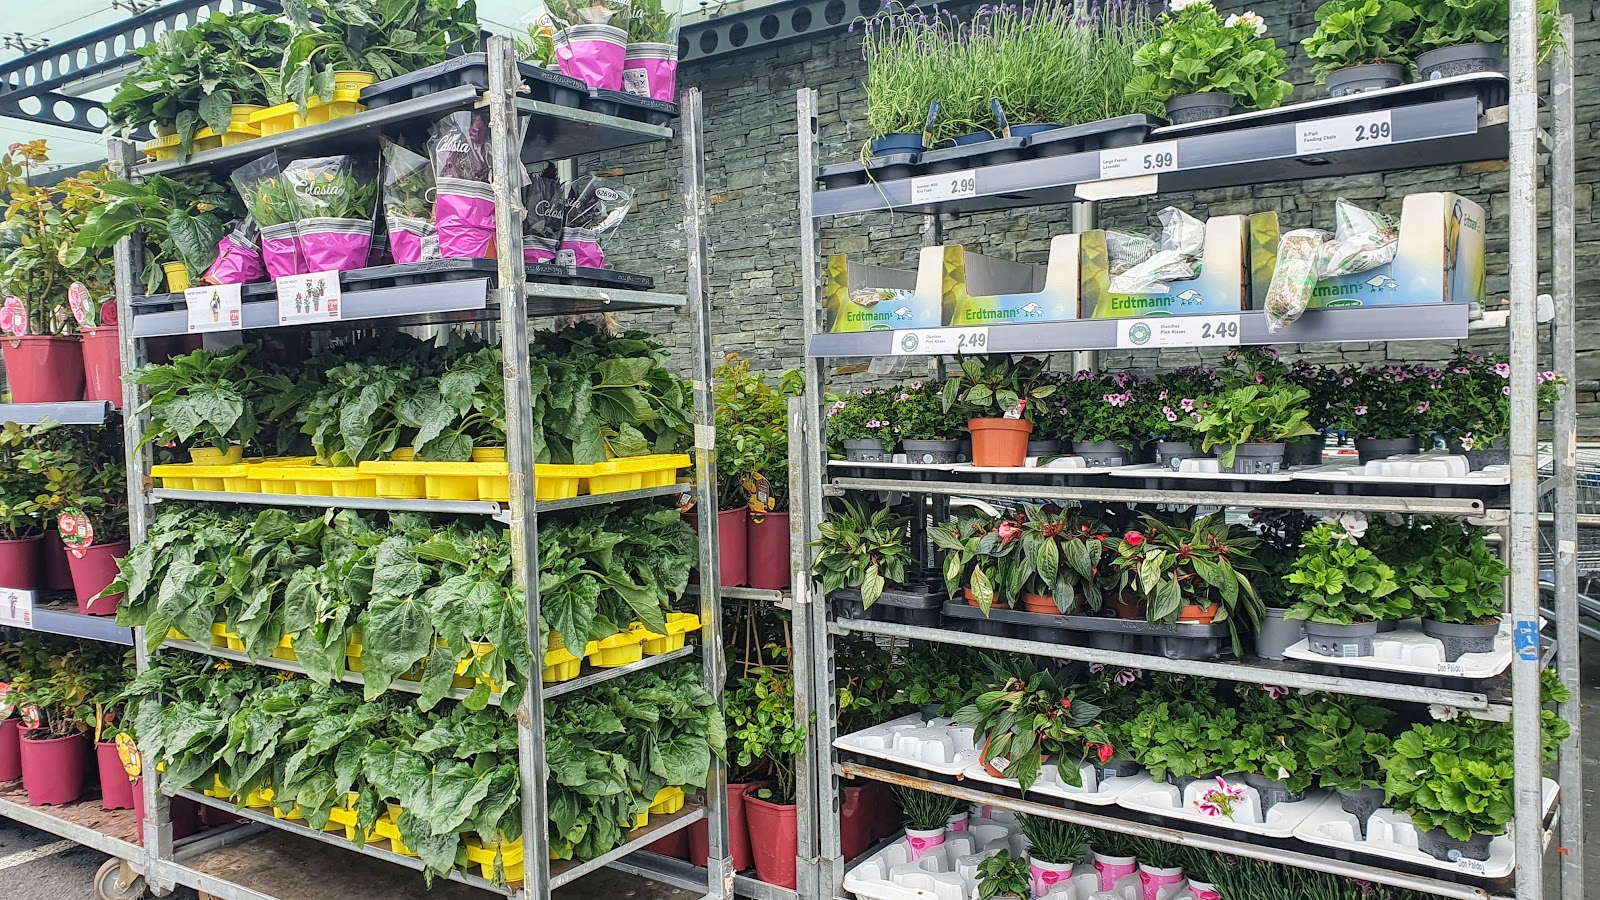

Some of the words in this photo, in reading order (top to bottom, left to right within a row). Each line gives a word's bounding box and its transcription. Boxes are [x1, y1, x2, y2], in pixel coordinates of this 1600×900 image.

[1355, 121, 1390, 142] 2.99
[1143, 152, 1172, 170] 5.99
[294, 180, 340, 196] Celosia
[951, 178, 975, 193] 2.99
[1312, 281, 1364, 297] tmann's
[1111, 294, 1175, 310] Erdtmann's
[847, 310, 893, 322] Erdtmann's
[966, 307, 1020, 320] Erdtmann's
[1201, 321, 1238, 339] 2.49
[957, 333, 986, 348] 2.49
[1437, 663, 1446, 672] Don
[1458, 858, 1467, 868] Don
